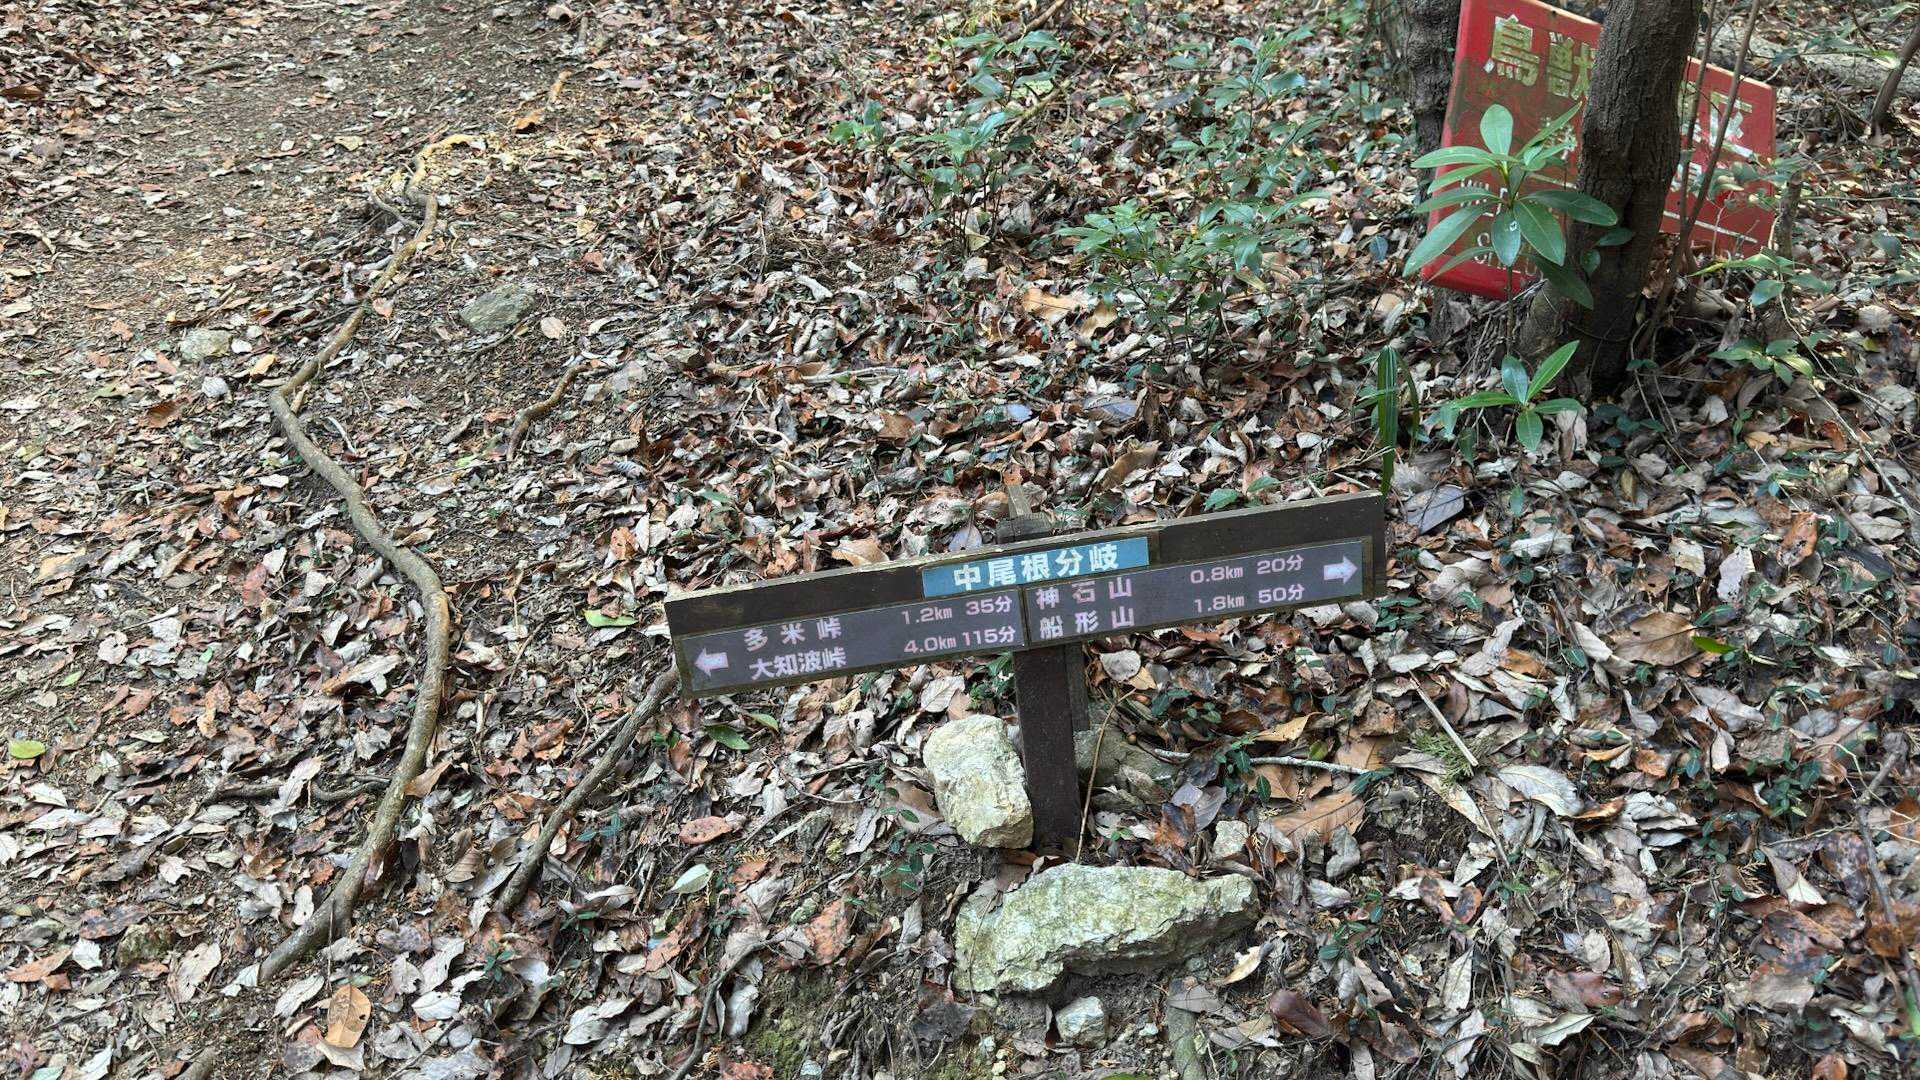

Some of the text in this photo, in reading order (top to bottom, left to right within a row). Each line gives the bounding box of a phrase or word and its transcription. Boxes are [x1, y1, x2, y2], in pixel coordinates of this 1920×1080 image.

[953, 543, 1120, 591] 中尾根分岐
[1035, 554, 1305, 610] 神石山 0.8km 20分
[743, 595, 1013, 652] 多米峠 1.2km 35分
[1039, 584, 1305, 640] 船形山 1.8km 50分
[749, 626, 1017, 681] 大知波峠 4.0km 115分
